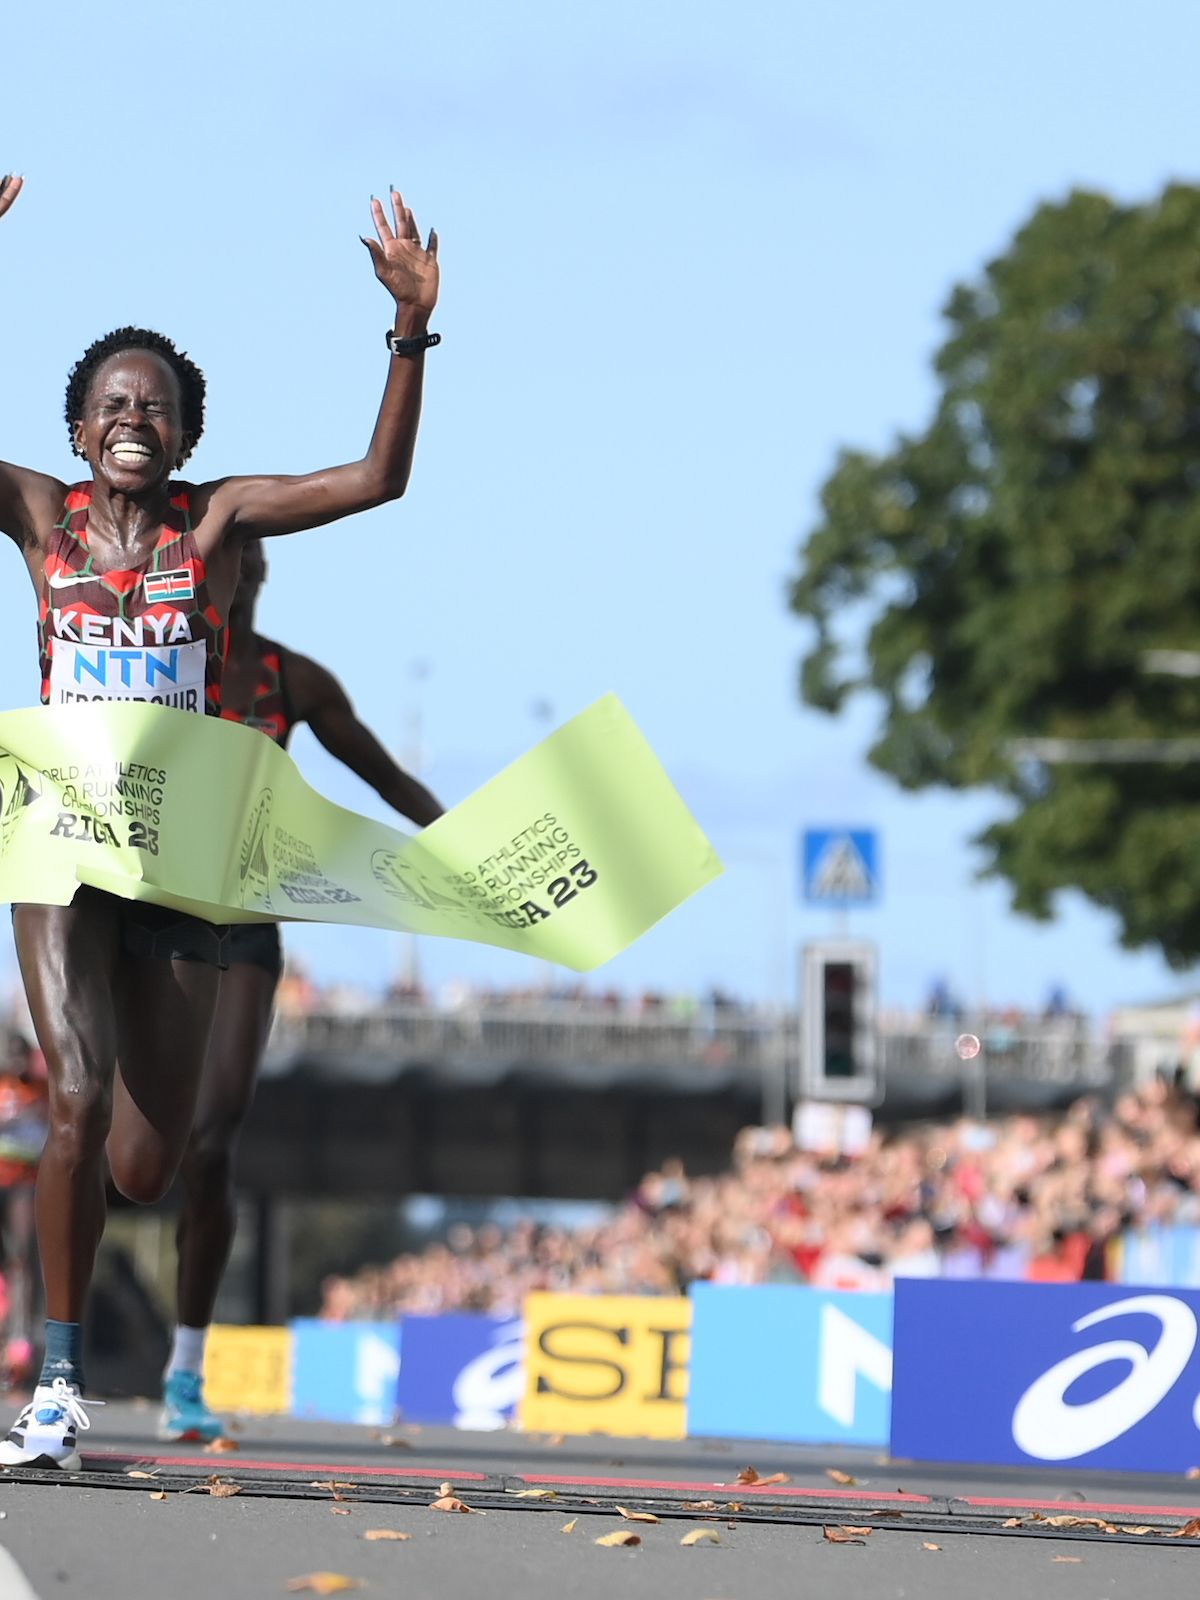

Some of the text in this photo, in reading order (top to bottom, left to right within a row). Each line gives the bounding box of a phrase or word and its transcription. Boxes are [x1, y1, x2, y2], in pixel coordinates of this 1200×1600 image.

[53, 608, 193, 647] KENYA
[73, 648, 180, 688] NTN
[41, 761, 167, 785] ORLD ALETICS
[82, 779, 164, 806] RUNNING
[128, 821, 160, 856] 23
[477, 812, 558, 878] ATHLETICS
[485, 827, 569, 893] RUNNING
[547, 858, 599, 909] 23
